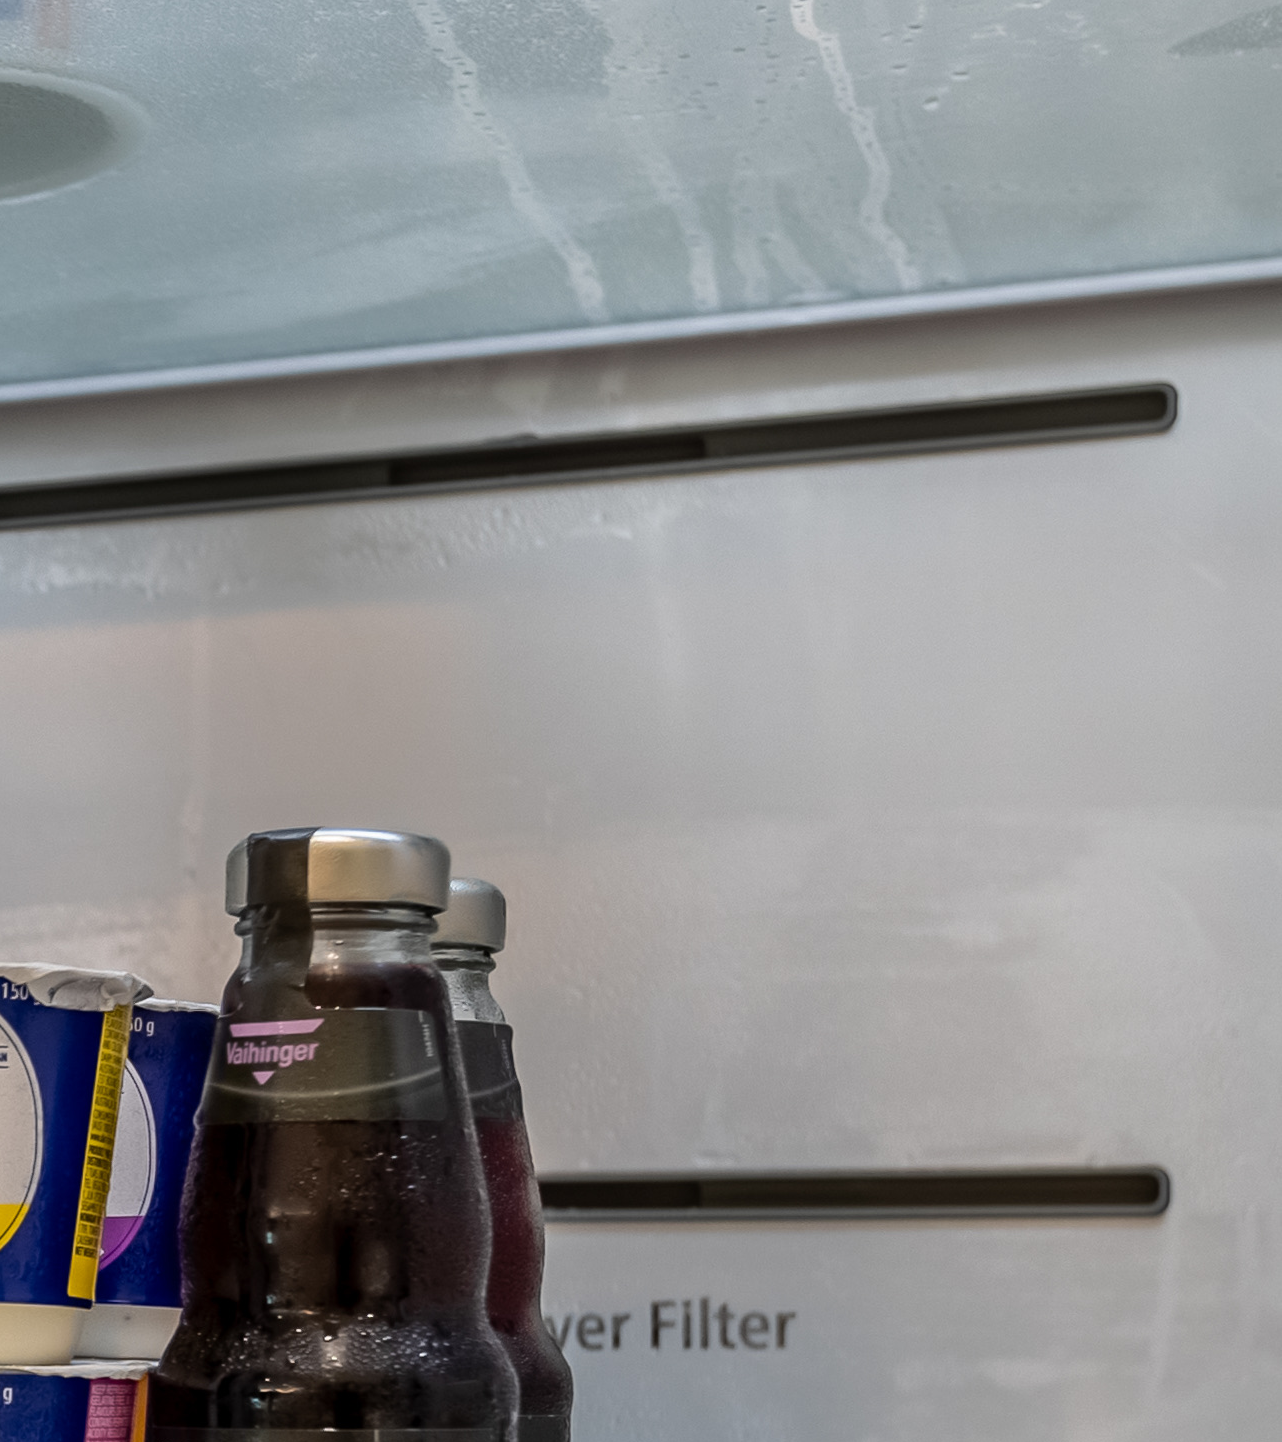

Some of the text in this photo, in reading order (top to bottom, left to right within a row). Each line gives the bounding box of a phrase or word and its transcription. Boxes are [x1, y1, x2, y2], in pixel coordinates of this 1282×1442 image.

[0, 982, 29, 1001] 150
[225, 1038, 319, 1068] Vaihinger
[649, 1297, 797, 1352] Filter
[2, 1386, 14, 1404] g
